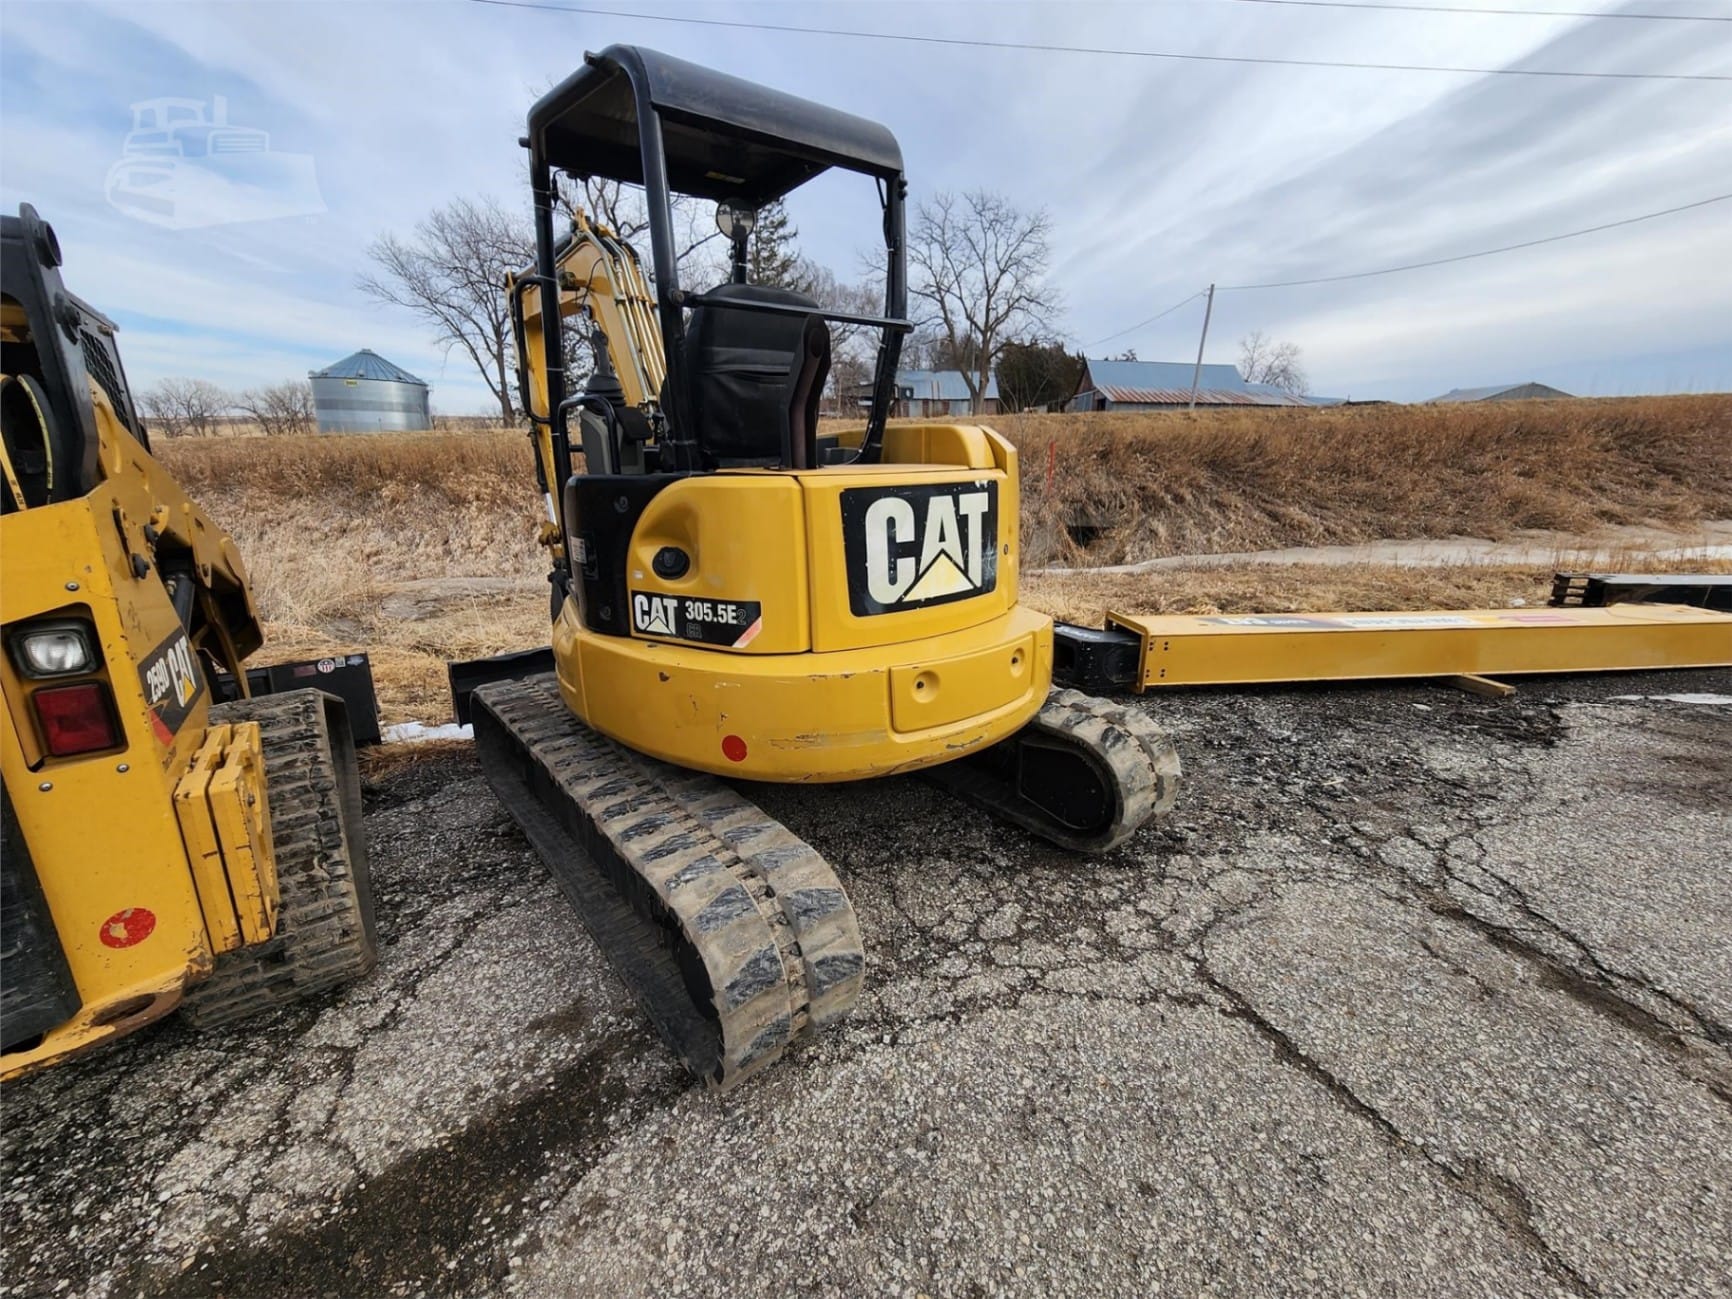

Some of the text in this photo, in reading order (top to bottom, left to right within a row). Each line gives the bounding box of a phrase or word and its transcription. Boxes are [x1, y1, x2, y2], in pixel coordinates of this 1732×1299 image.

[865, 492, 989, 605] CAT
[634, 594, 678, 635] CAT
[147, 635, 197, 708] 259D CAT
